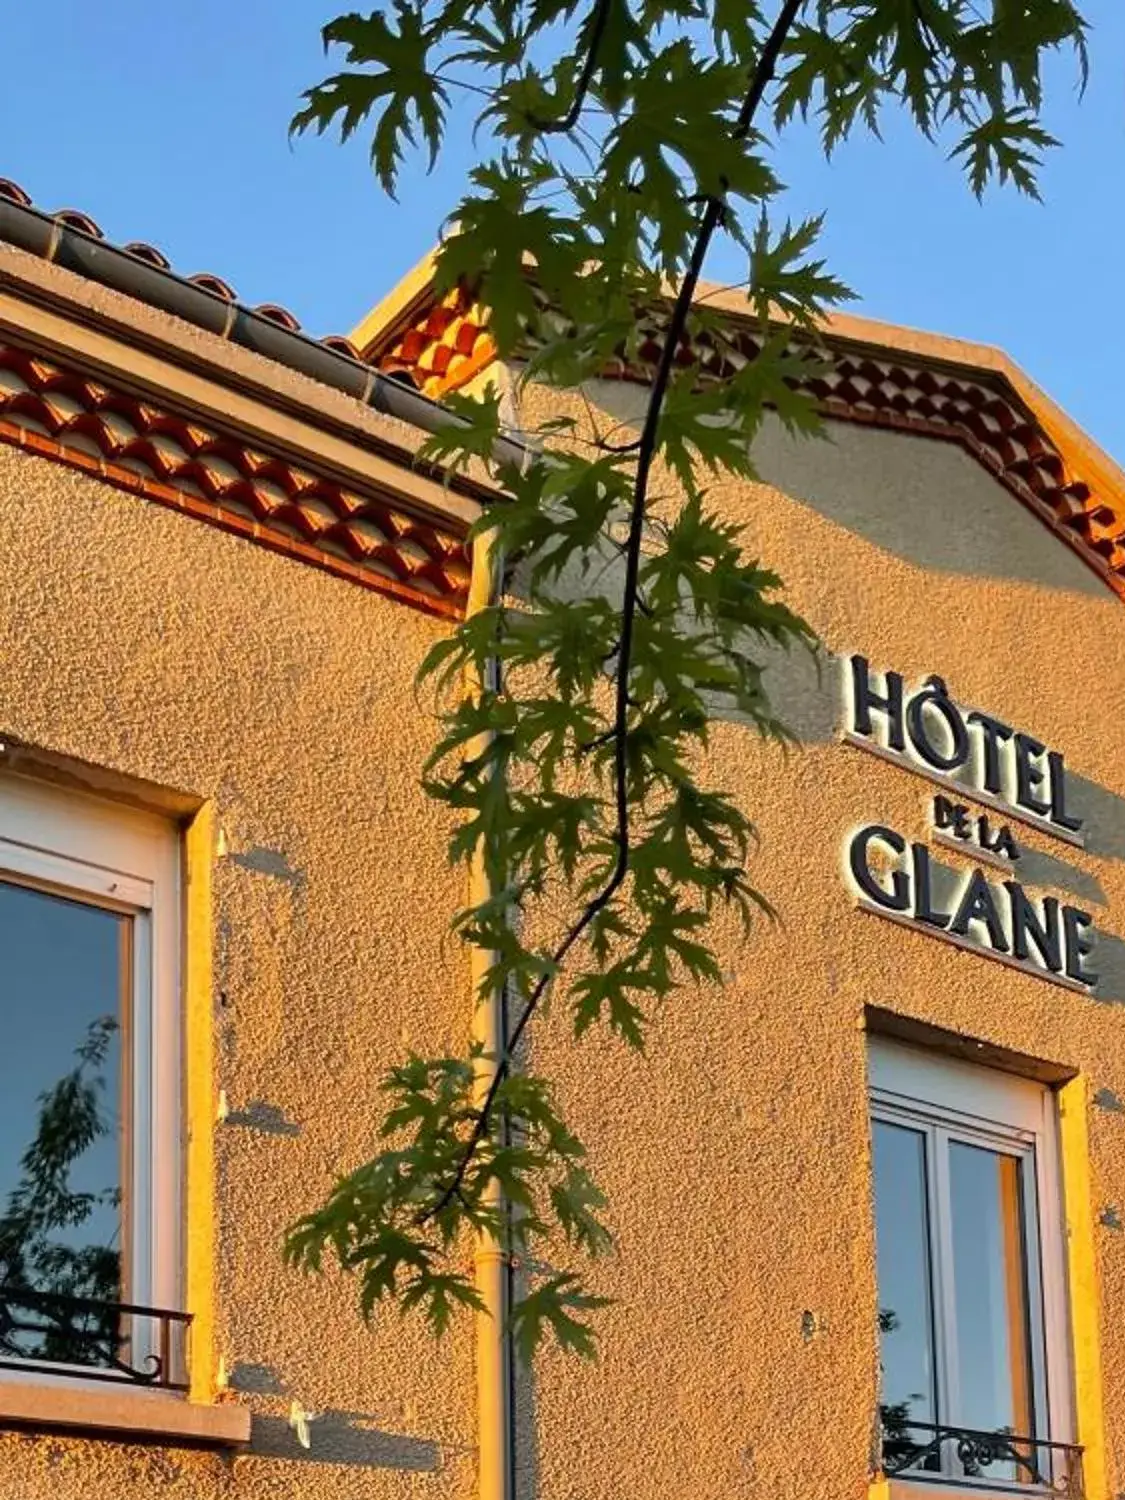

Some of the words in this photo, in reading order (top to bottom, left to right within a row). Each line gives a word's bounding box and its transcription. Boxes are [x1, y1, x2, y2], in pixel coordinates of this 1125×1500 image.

[850, 654, 1084, 831] HÔTEL
[850, 825, 1099, 986] GLANE
[934, 795, 973, 839] DE
[978, 814, 1020, 860] LA
